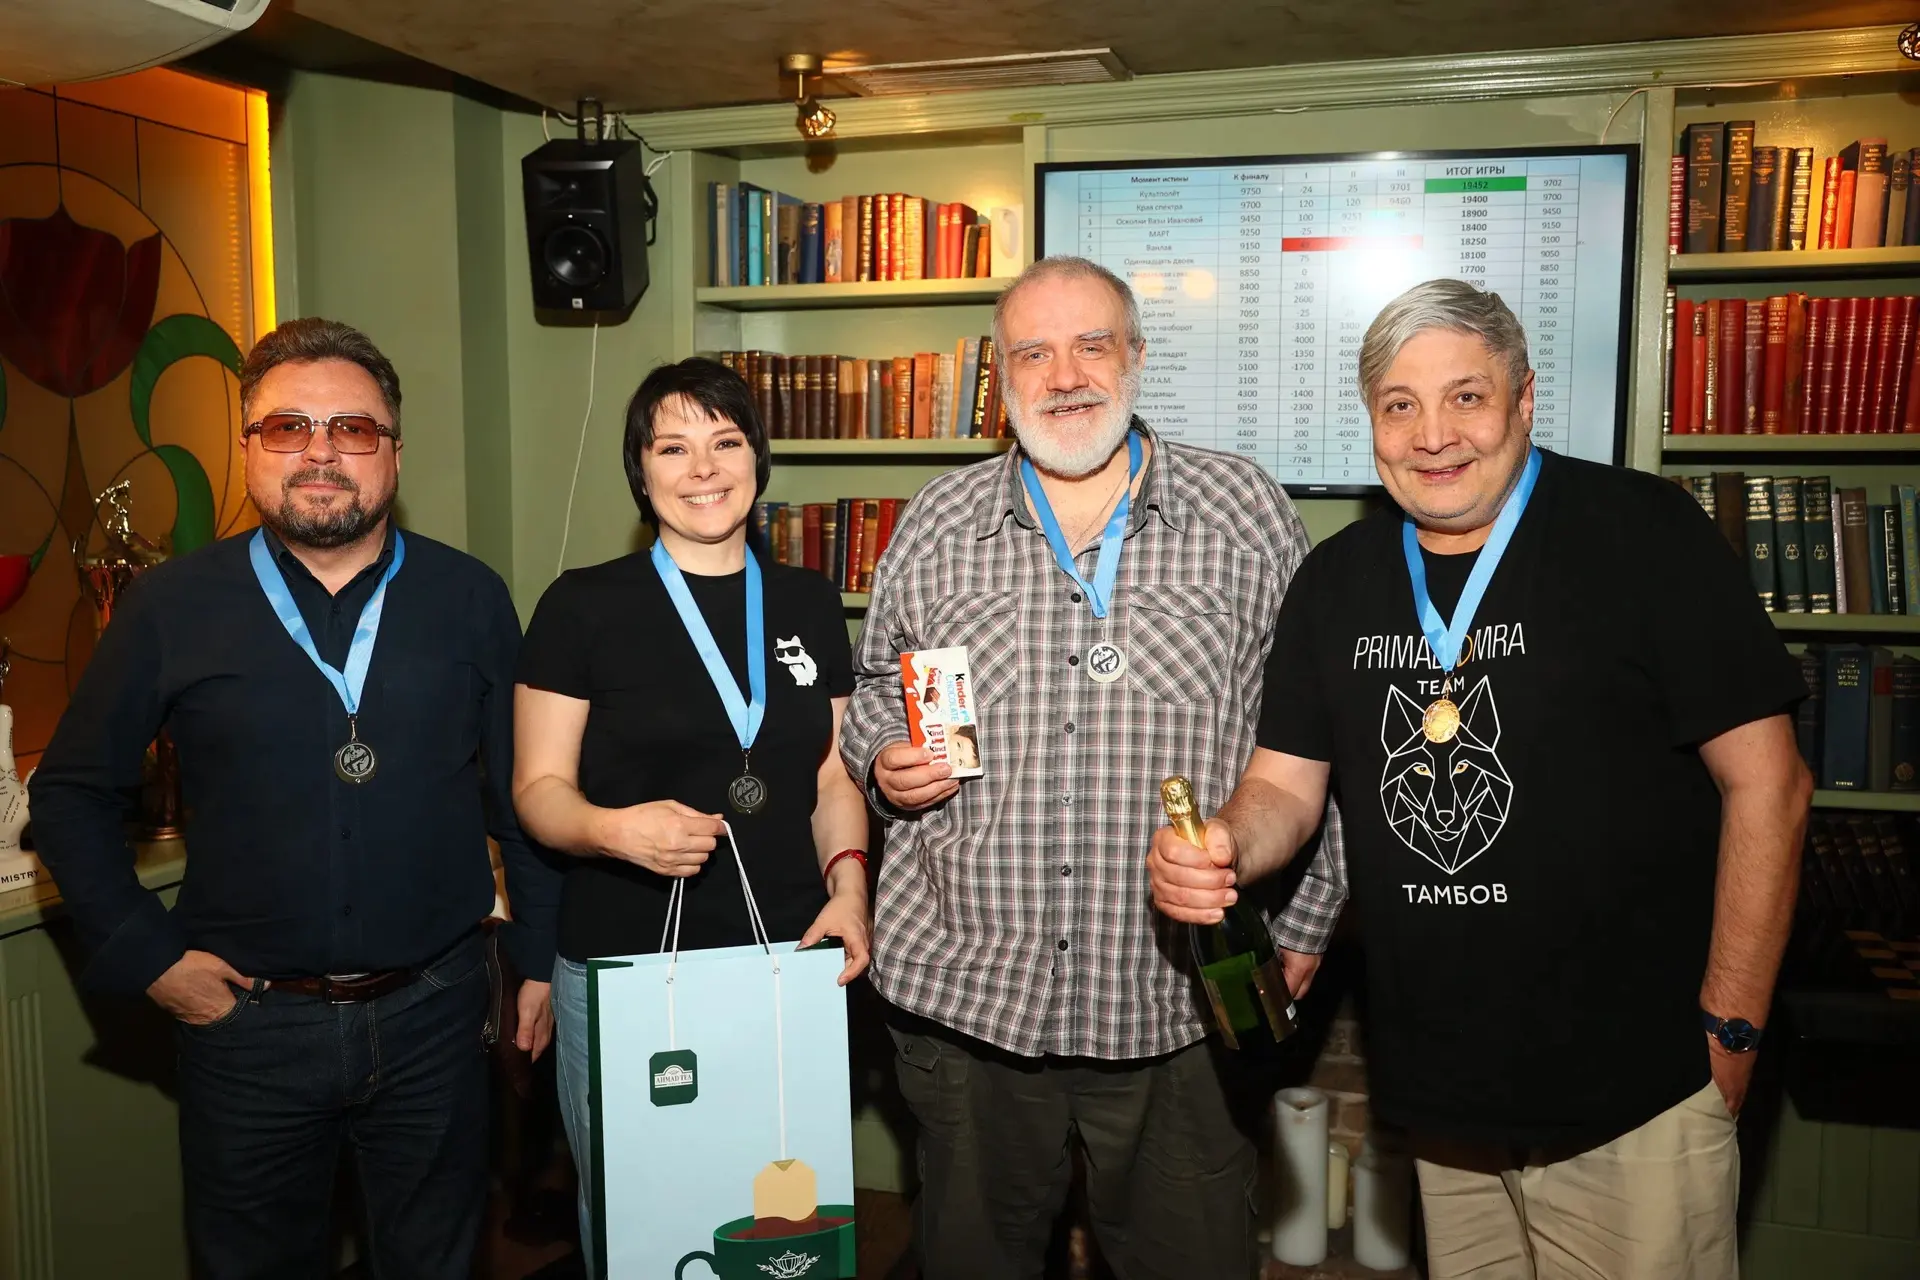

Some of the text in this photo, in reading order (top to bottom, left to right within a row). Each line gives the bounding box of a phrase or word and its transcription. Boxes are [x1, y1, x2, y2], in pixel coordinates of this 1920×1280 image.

[1131, 175, 1161, 184] Момент
[1162, 175, 1189, 183] истины
[1234, 173, 1239, 181] К
[1240, 172, 1269, 182] финалу
[1446, 166, 1474, 176] ИТОГ
[1476, 165, 1505, 175] ИГРЫ
[1240, 187, 1261, 196] 9750
[1348, 184, 1358, 193] 25
[1462, 181, 1488, 190] 19452
[1543, 179, 1562, 188] 9702
[1240, 200, 1261, 209] 9700
[1299, 199, 1314, 209] 120
[1346, 198, 1361, 207] 120
[1462, 195, 1488, 204] 19400
[1543, 192, 1562, 201] 9700
[1240, 214, 1261, 223] 9450
[1299, 213, 1313, 222] 100
[1461, 209, 1487, 218] 18900
[1542, 207, 1561, 216] 9450
[1149, 230, 1169, 238] МАРТ
[1240, 228, 1260, 237] 9250
[1461, 223, 1487, 232] 18400
[1541, 221, 1561, 230] 9150
[1240, 241, 1260, 250] 9150
[1460, 237, 1486, 246] 18250
[1541, 235, 1560, 244] 9100
[1240, 255, 1260, 264] 9050
[1460, 250, 1486, 260] 18100
[1540, 249, 1559, 258] 9050
[1239, 268, 1260, 278] 8850
[1459, 265, 1486, 274] 17700
[1540, 263, 1559, 272] 8850
[1239, 282, 1259, 291] 8400
[1539, 277, 1558, 286] 8400
[1239, 295, 1259, 304] 7300
[1539, 291, 1558, 300] 7300
[1239, 309, 1259, 318] 7050
[1539, 305, 1557, 314] 7000
[1239, 322, 1259, 331] 9950
[1538, 319, 1556, 328] 3350
[1238, 336, 1259, 345] 8700
[1291, 336, 1315, 344] -4000
[1539, 333, 1554, 342] 700
[1238, 349, 1258, 358] 7350
[1291, 349, 1314, 358] -1350
[1538, 347, 1553, 356] 650
[1238, 363, 1258, 371] 5100
[1291, 363, 1314, 371] -1700
[1536, 361, 1555, 370] 1700
[1238, 376, 1258, 385] 3100
[1300, 376, 1305, 385] 0
[1536, 375, 1554, 384] 3100
[1237, 389, 1258, 398] 4300
[1290, 389, 1313, 398] -1400
[1535, 389, 1554, 398] 1500
[1237, 402, 1258, 411] 6950
[1290, 402, 1313, 411] -2300
[1337, 402, 1358, 411] 2350
[1237, 416, 1257, 425] 7650
[1295, 416, 1309, 425] 100
[1336, 416, 1359, 425] -7360
[1237, 429, 1257, 438] 4400
[1294, 429, 1309, 438] 200
[1336, 429, 1359, 438] -4000
[1237, 442, 1352, 452] 6800 -50 50
[1289, 456, 1312, 464] -7748
[1297, 469, 1303, 478] 0
[1416, 676, 1465, 695] TEAM
[946, 674, 959, 722] CHOCOLATE
[1, 869, 40, 885] MISTRY
[1402, 883, 1508, 905] ТАМБОВ
[656, 1075, 680, 1084] AHMAD
